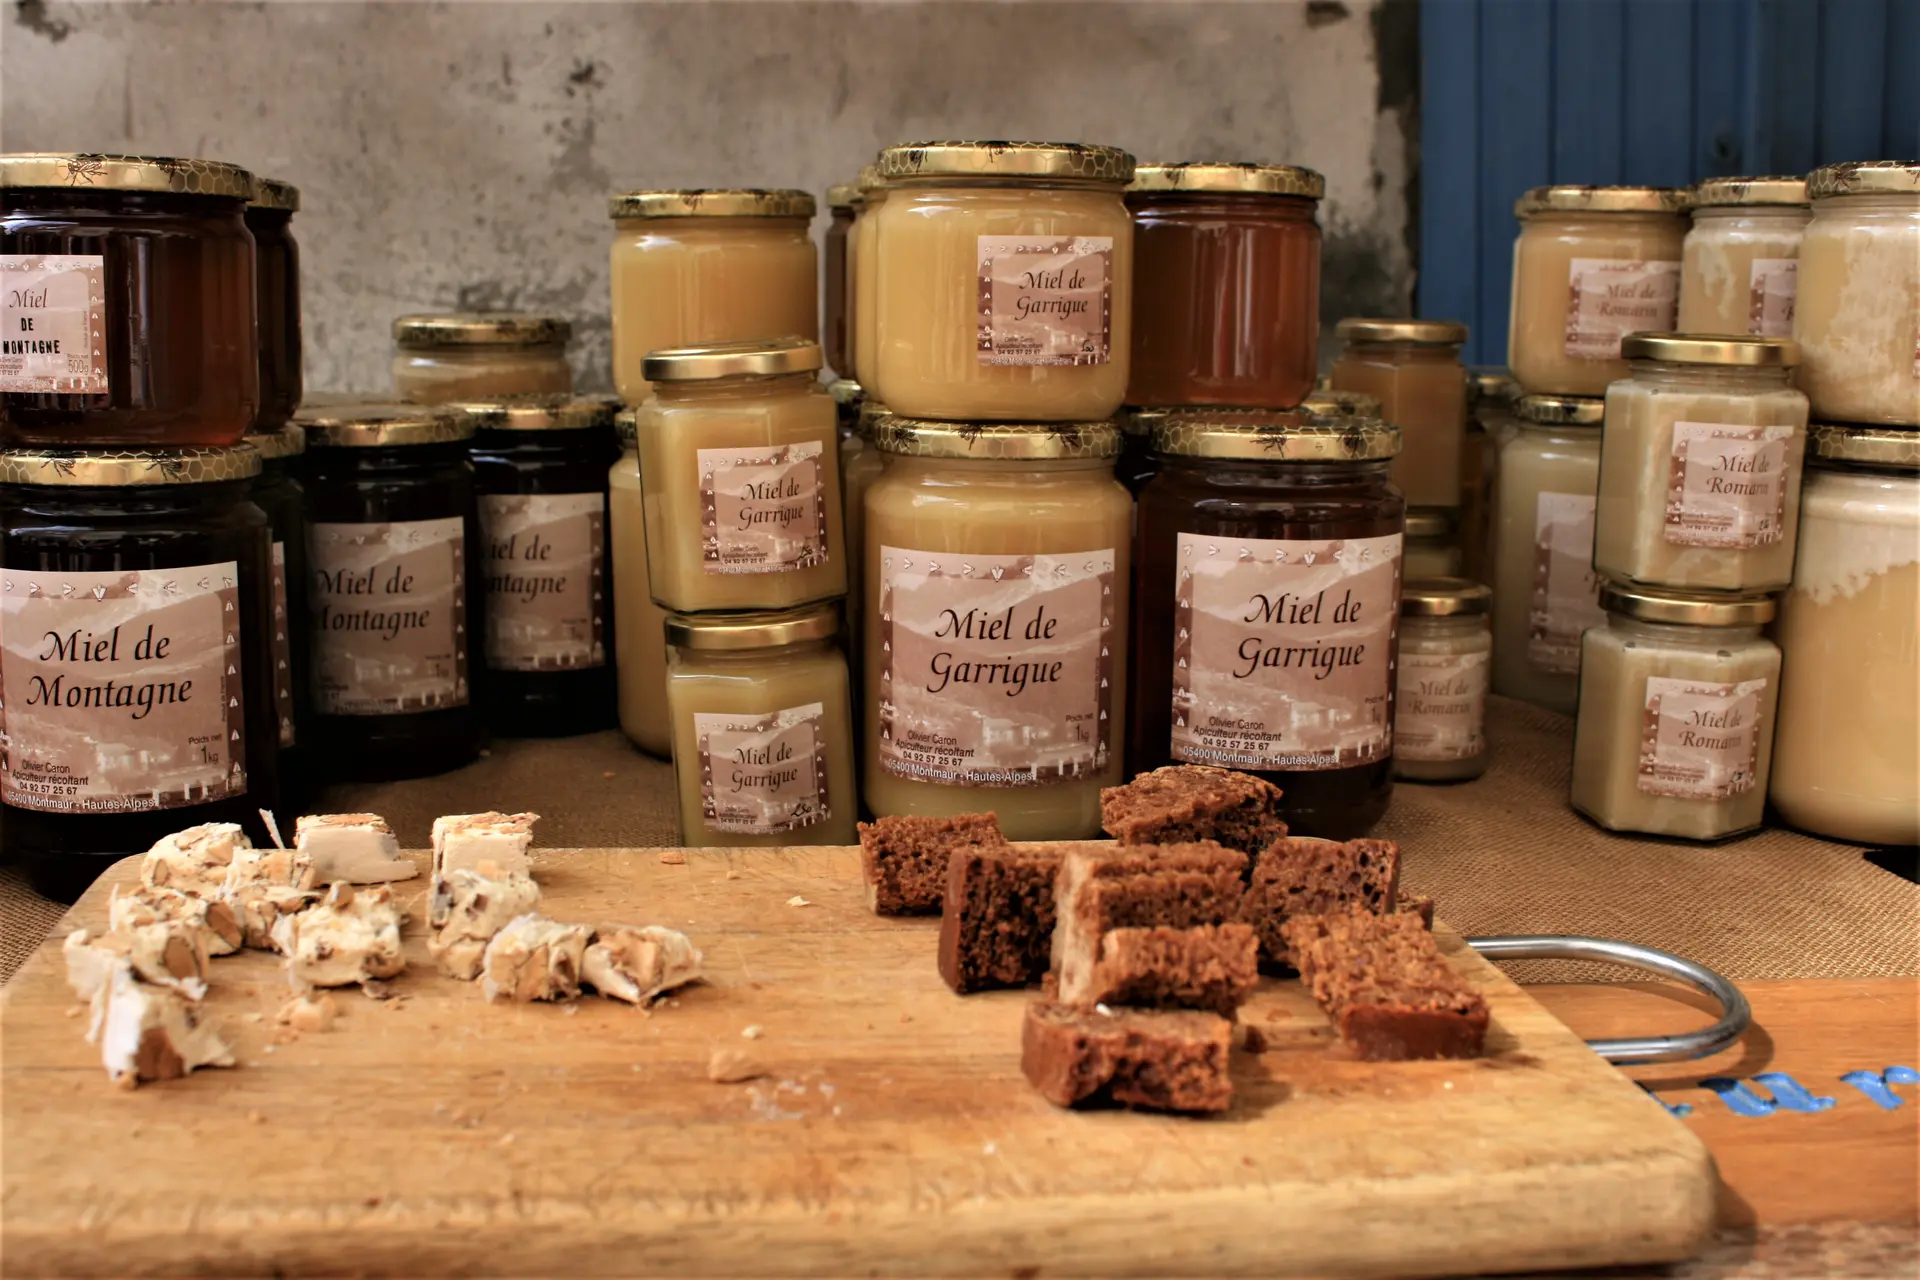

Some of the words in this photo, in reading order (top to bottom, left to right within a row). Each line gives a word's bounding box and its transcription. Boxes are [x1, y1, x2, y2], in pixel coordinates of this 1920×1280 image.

[1019, 269, 1063, 290] Miel
[1069, 268, 1086, 290] de
[9, 288, 49, 309] Miel
[1014, 296, 1089, 321] Garrigue
[20, 317, 35, 332] DE
[2, 339, 61, 355] MONTAGNE
[67, 359, 89, 376] 500g
[1711, 453, 1757, 473] Miel
[1758, 454, 1769, 474] de
[740, 479, 784, 501] Miel
[787, 477, 800, 498] de
[737, 505, 804, 532] Garrigue
[524, 533, 552, 562] de
[385, 565, 415, 594] de
[490, 571, 567, 603] ntagne
[1243, 589, 1324, 625] Miel
[1333, 589, 1362, 625] de
[934, 604, 1016, 641] Miel
[1024, 604, 1058, 640] de
[39, 626, 121, 662] Miel
[133, 624, 171, 661] de
[1232, 637, 1366, 681] Garrigue
[926, 652, 1063, 698] Garrigue
[26, 674, 193, 720] Montagne
[1208, 716, 1236, 730] Olivier
[1238, 719, 1265, 731] Caron
[1684, 709, 1730, 729] Miel
[188, 735, 210, 746] Poids
[907, 730, 931, 744] Olivier
[932, 733, 957, 746] Caron
[1193, 724, 1238, 740] Apiculteur
[732, 743, 771, 765] Miel
[776, 742, 793, 763] de
[895, 738, 933, 755] Apiculteur
[1202, 737, 1214, 746] 04
[1215, 738, 1227, 748] 92
[1229, 740, 1241, 749] 57
[1243, 741, 1256, 751] 25
[1257, 742, 1270, 751] 67
[22, 759, 44, 773] Olivier
[45, 762, 71, 774] Caron
[902, 751, 913, 760] 04
[914, 753, 925, 762] 92
[926, 755, 937, 763] 57
[938, 757, 950, 766] 25
[952, 758, 963, 767] 67
[1183, 746, 1211, 759] 05400
[1212, 750, 1264, 765] Montmaur
[1272, 754, 1337, 766] Hautes-Alpes
[12, 768, 46, 784] Apiculteur
[731, 768, 799, 794] Garrigue
[887, 761, 910, 773] 05400
[911, 764, 957, 780] Montmaur
[965, 771, 1033, 783] Hautes-Alpes
[19, 783, 29, 791] 04
[28, 784, 39, 793] 92
[40, 785, 51, 794] 57
[53, 786, 65, 795] 25
[66, 786, 78, 796] 67
[28, 795, 74, 810] Montmaur
[82, 798, 157, 811] Hautes-Alpes
